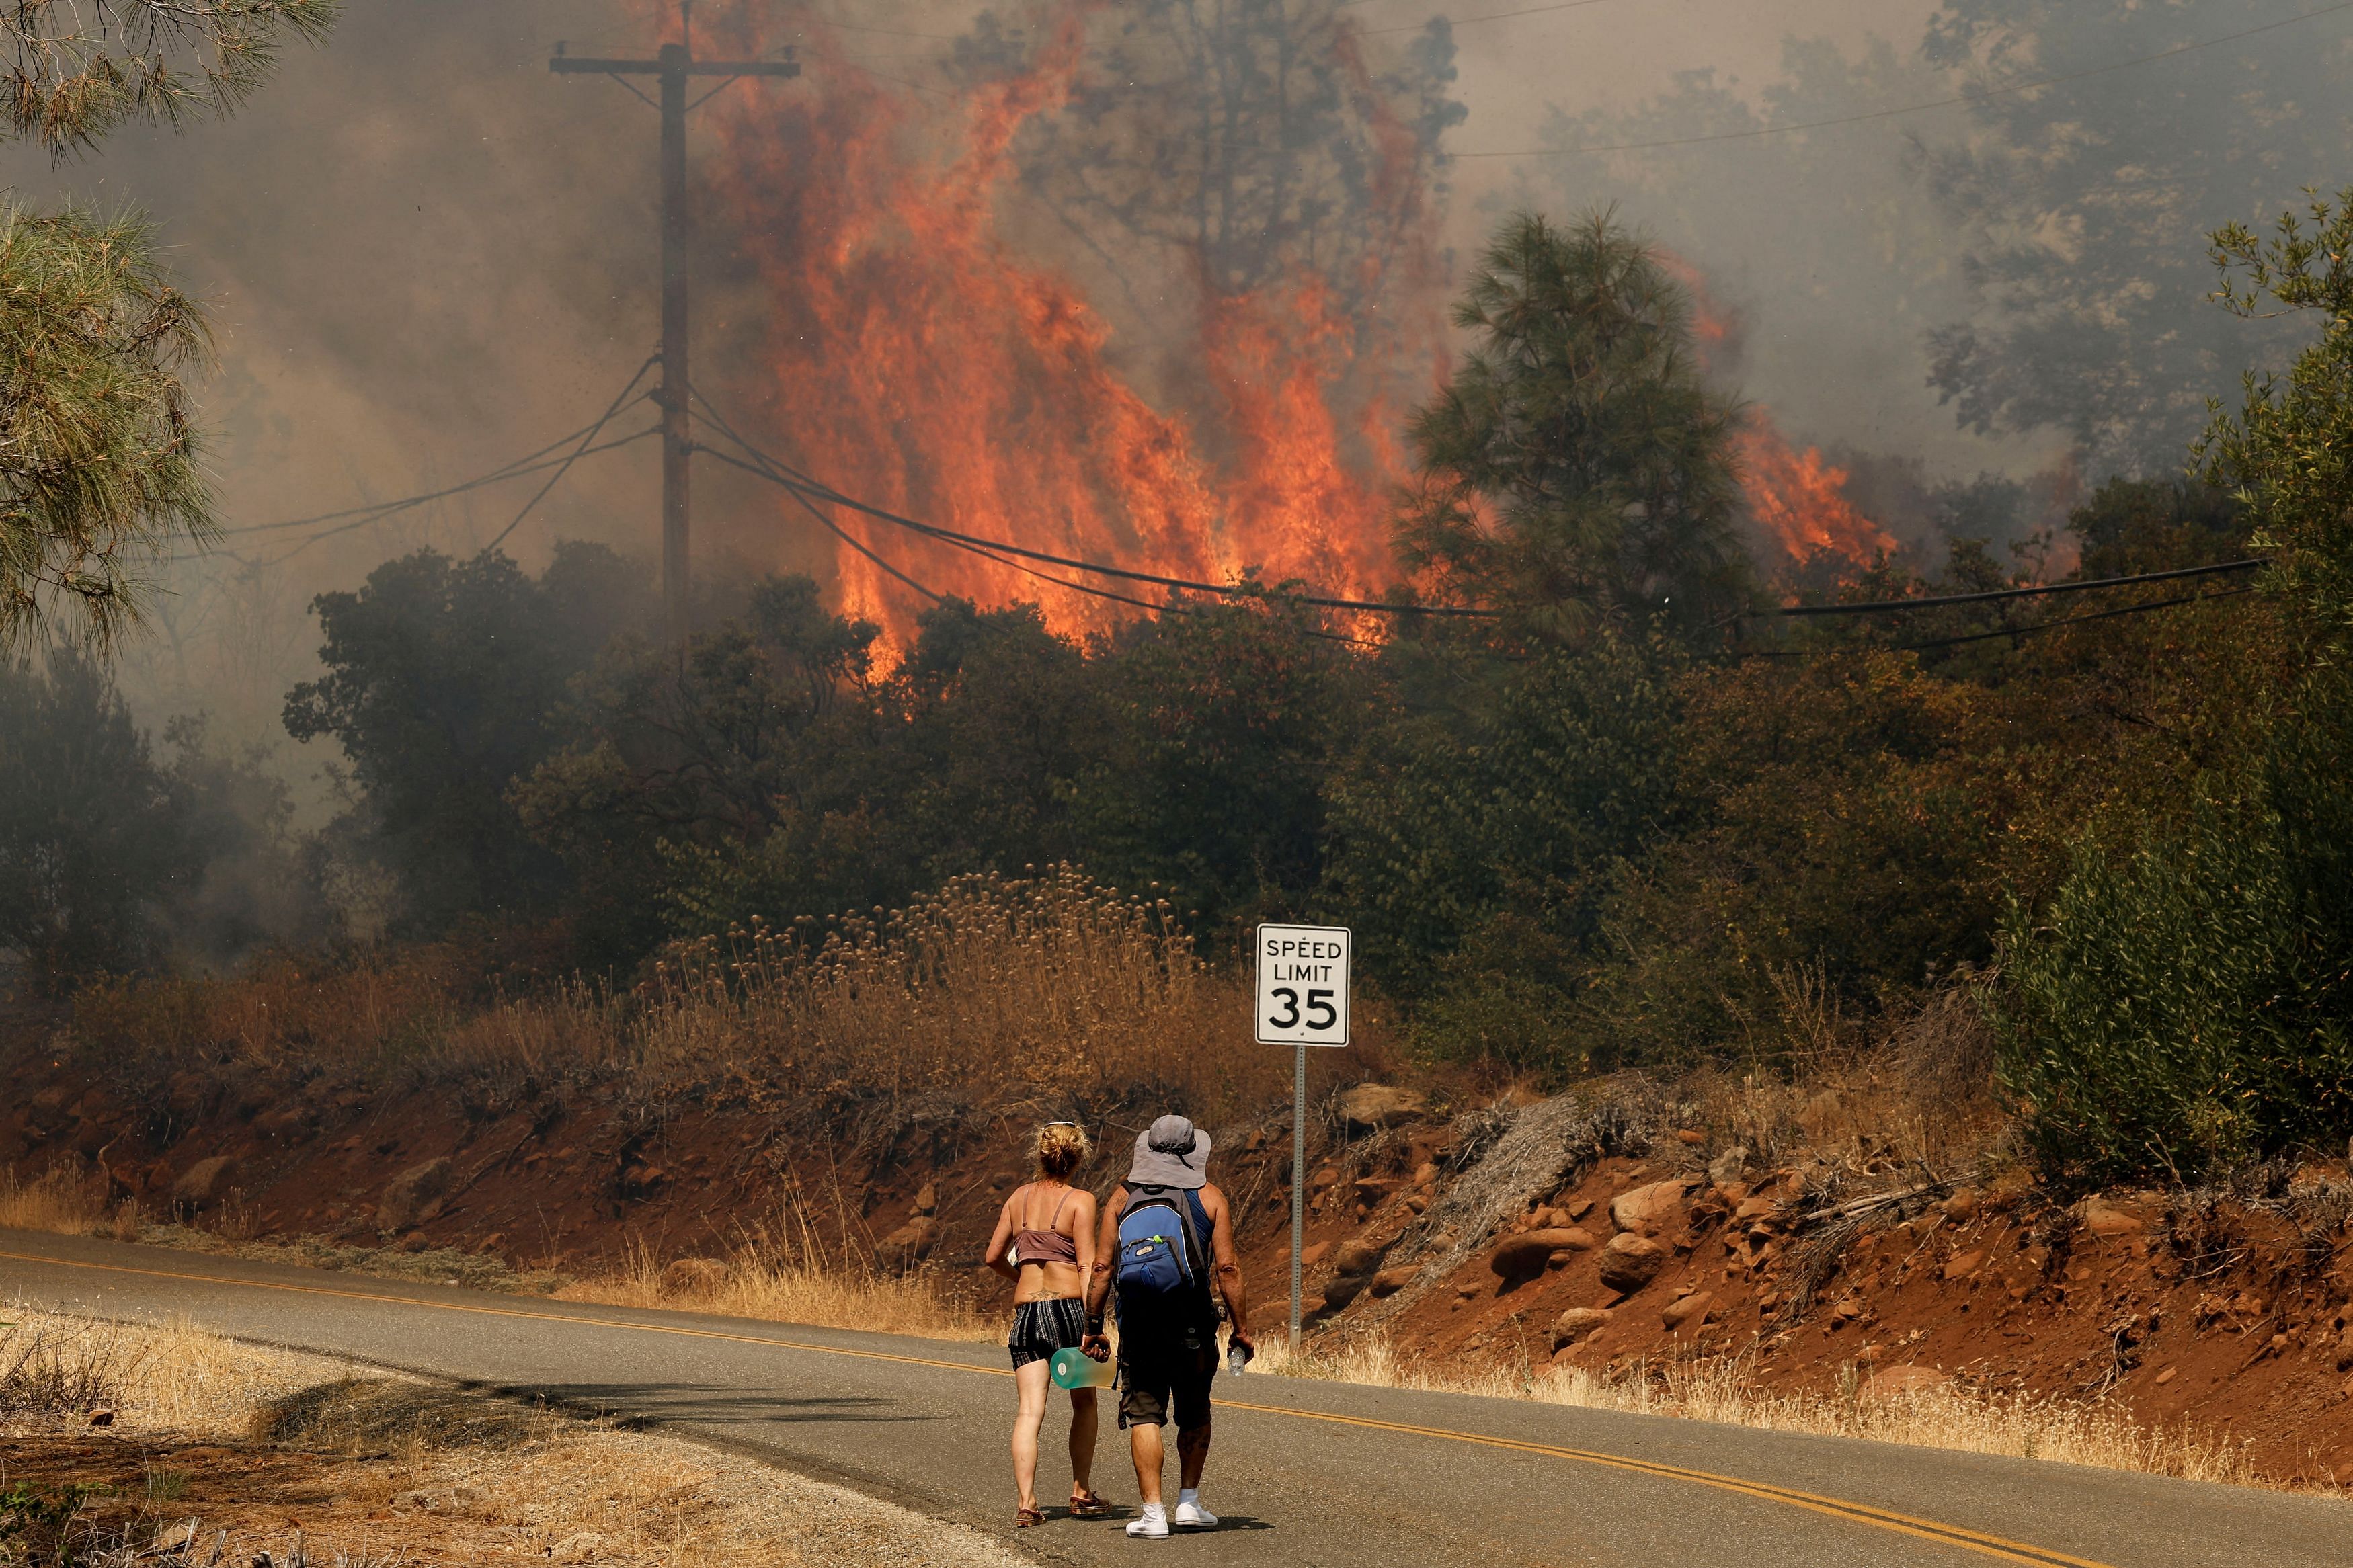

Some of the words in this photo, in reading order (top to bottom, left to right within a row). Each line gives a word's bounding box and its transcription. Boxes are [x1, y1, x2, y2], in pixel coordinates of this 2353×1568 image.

[1267, 940, 1341, 959] SPEED
[1275, 964, 1332, 982] LIMIT
[1269, 987, 1337, 1030] 35
